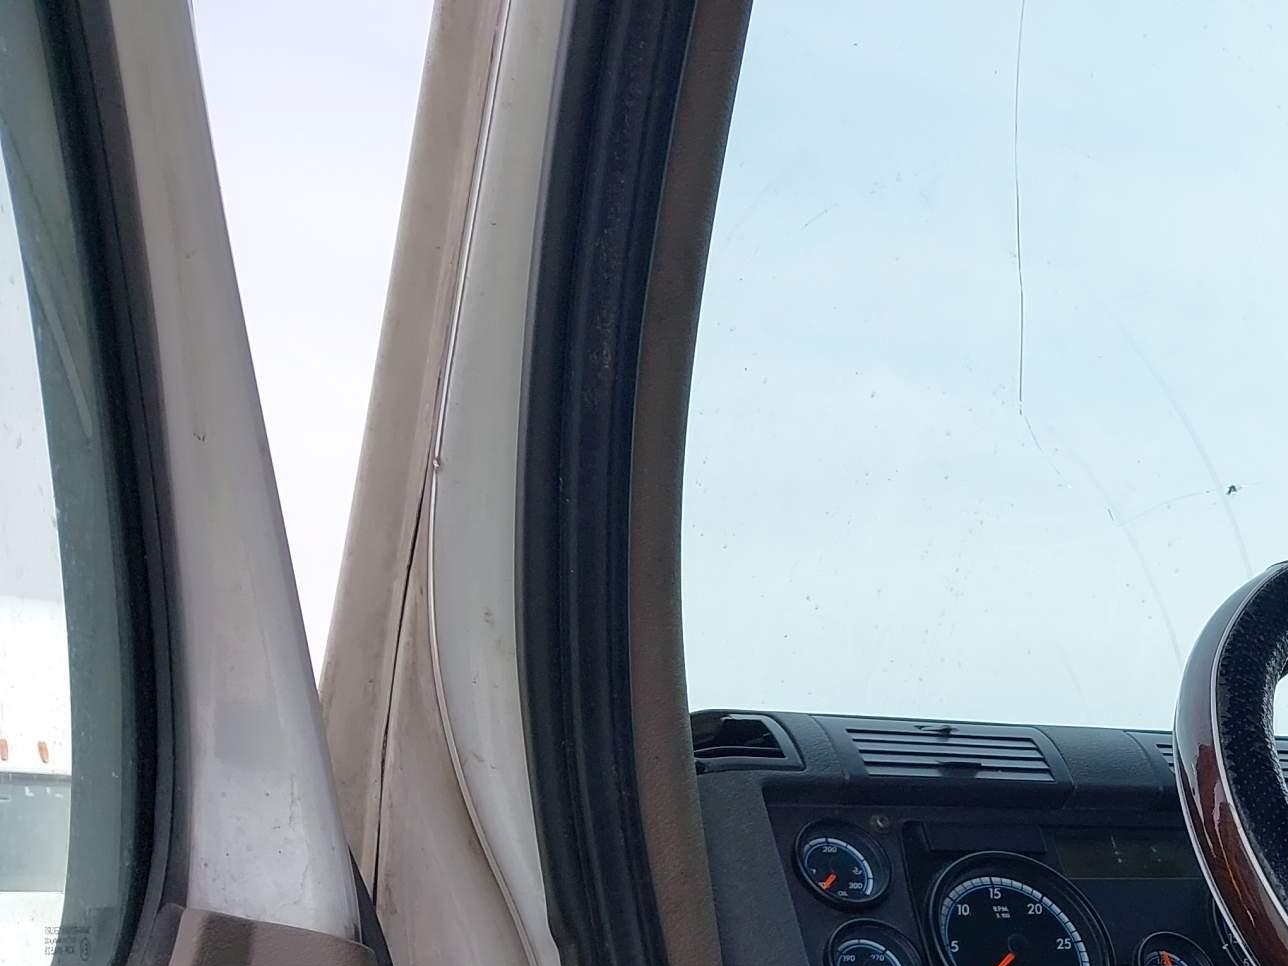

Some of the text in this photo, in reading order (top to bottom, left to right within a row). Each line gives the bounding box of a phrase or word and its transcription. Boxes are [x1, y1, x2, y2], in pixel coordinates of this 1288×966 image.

[989, 888, 1002, 899] 15
[957, 904, 970, 916] 10
[1027, 903, 1043, 915] 20
[951, 940, 959, 952] 5
[1056, 938, 1072, 950] 25
